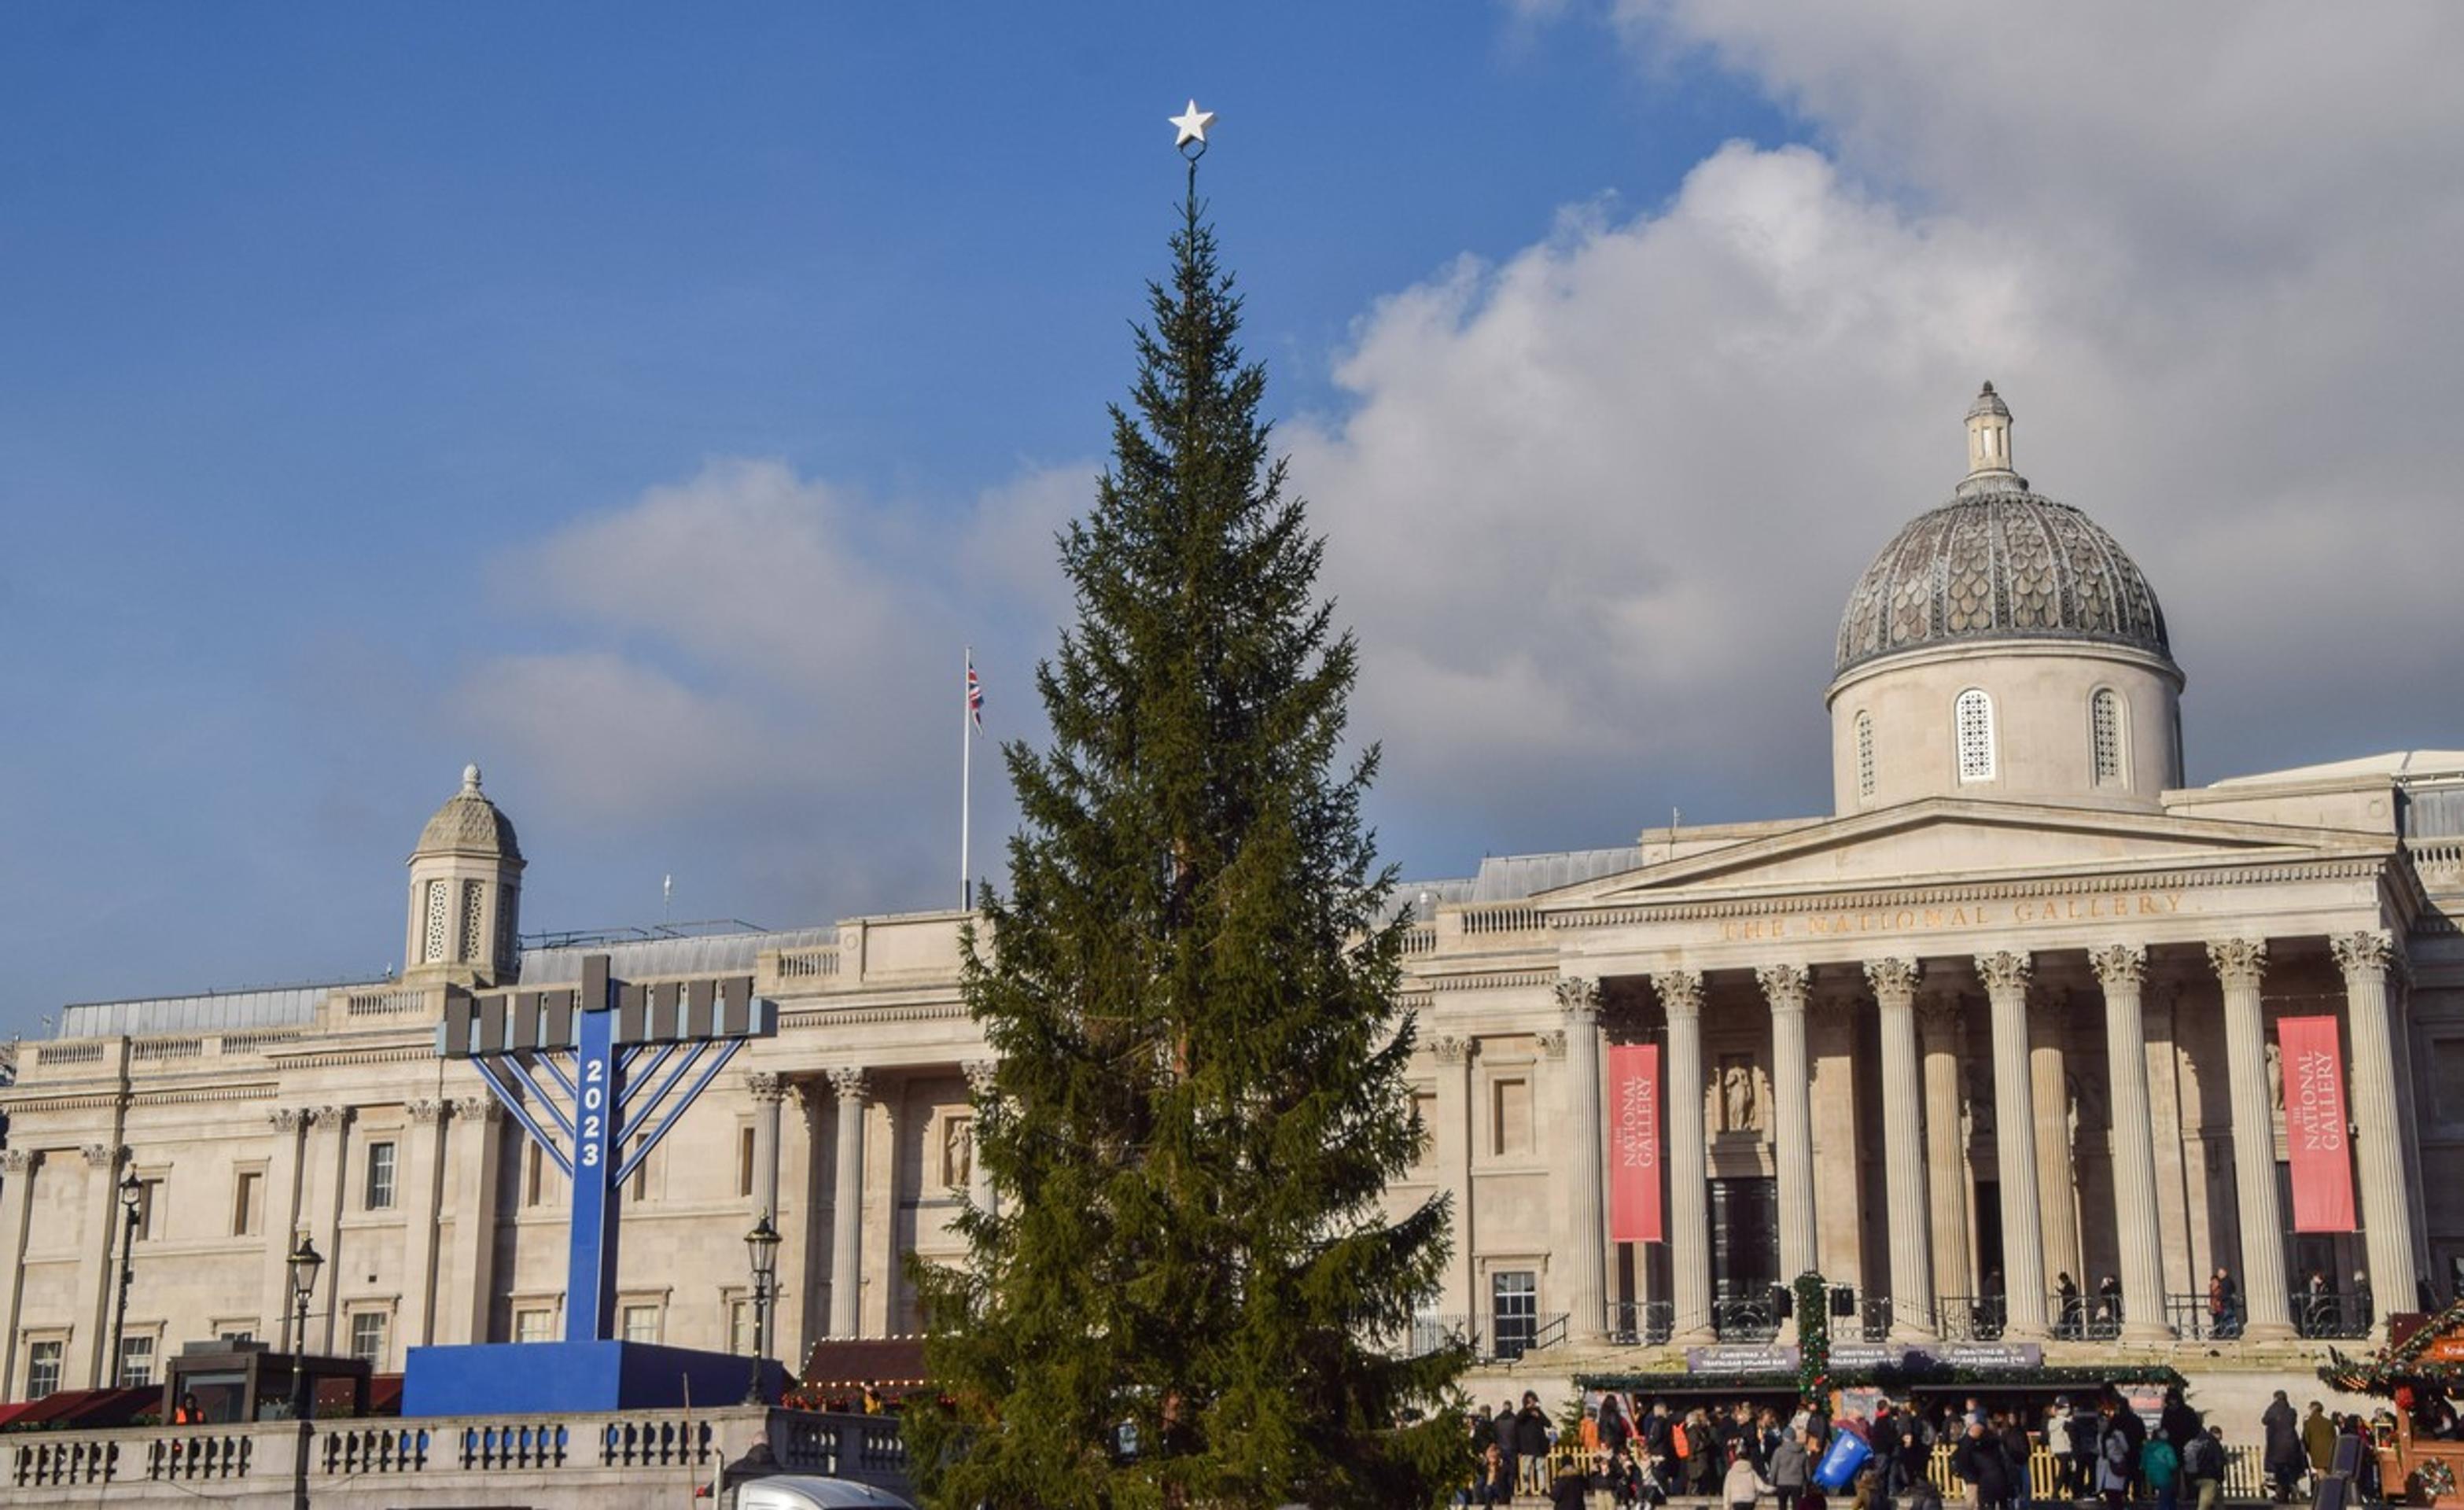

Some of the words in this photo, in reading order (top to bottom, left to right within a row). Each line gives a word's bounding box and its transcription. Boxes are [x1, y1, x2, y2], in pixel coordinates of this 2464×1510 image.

[1719, 919, 1784, 940] THE
[1810, 907, 1989, 934] NATIONAL
[582, 1059, 602, 1166] 2023
[1623, 1075, 1636, 1167] NATIONAL
[1637, 1077, 1652, 1168] GALLERY
[2299, 1050, 2322, 1151] NATIONAL
[2315, 1051, 2341, 1151] GALLERY
